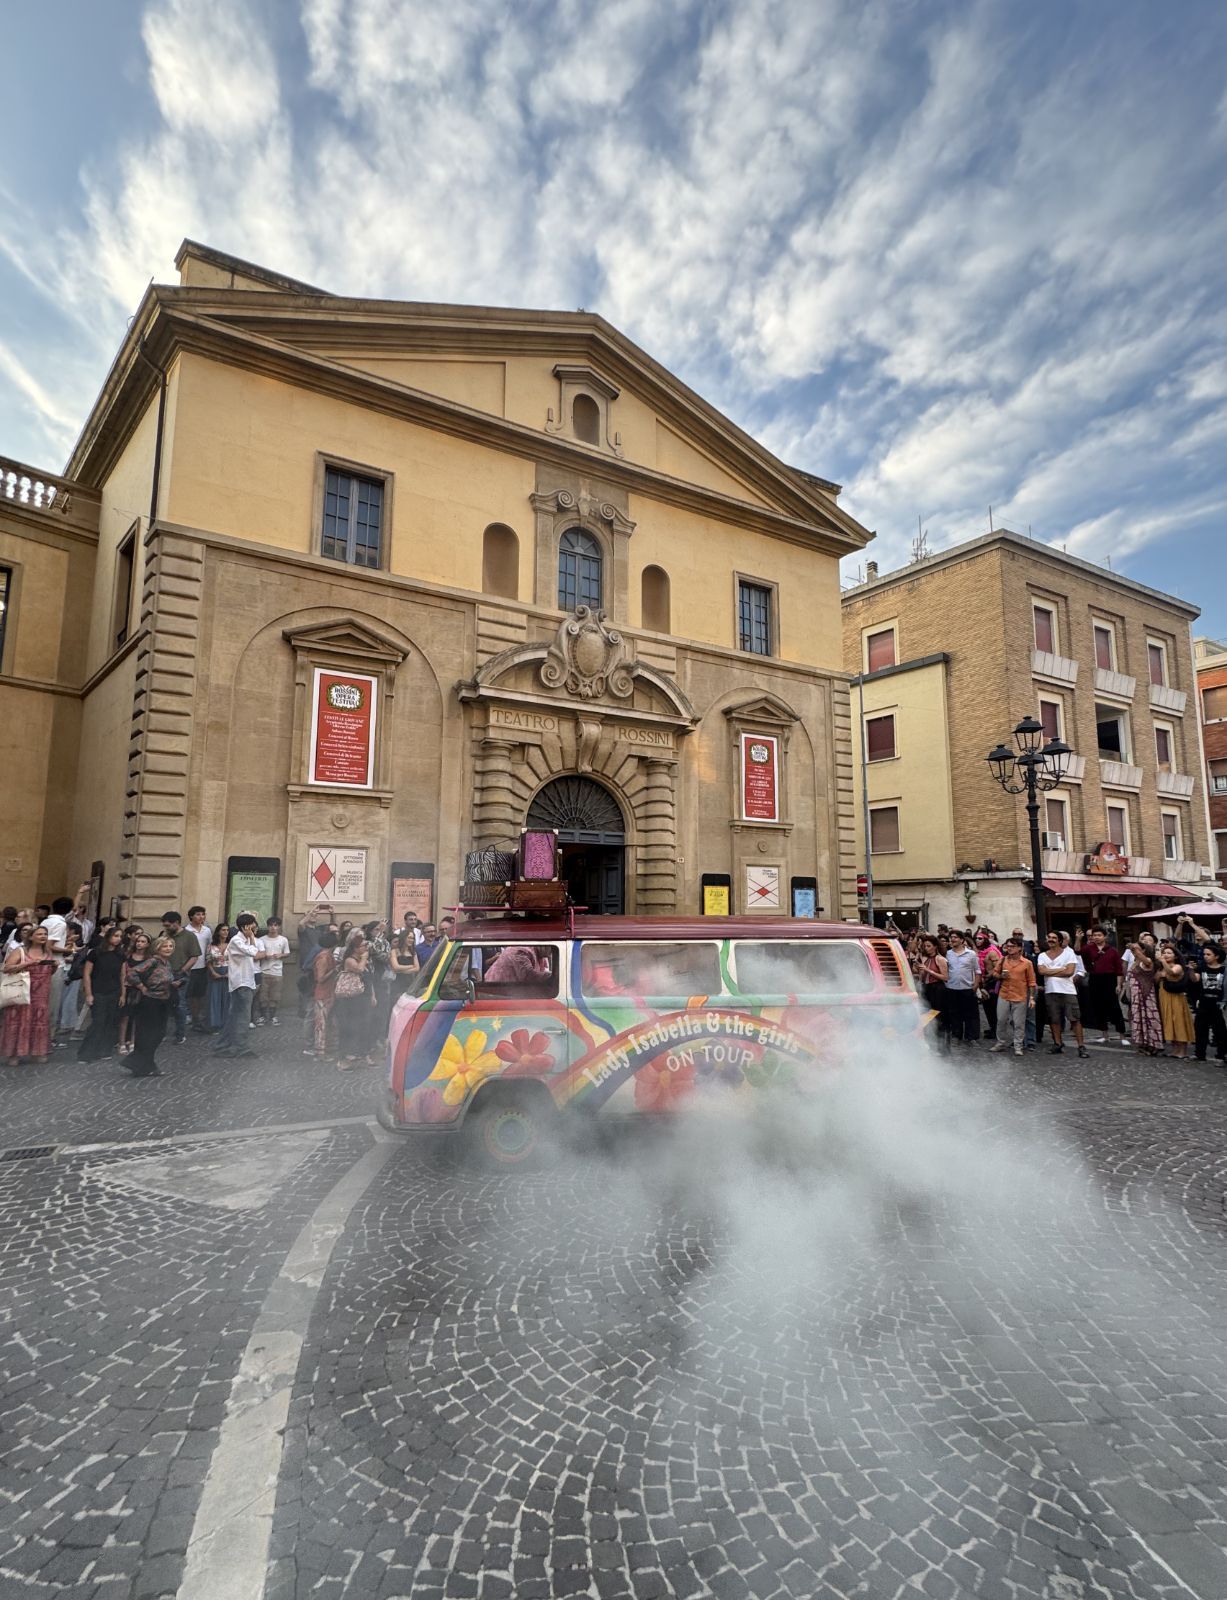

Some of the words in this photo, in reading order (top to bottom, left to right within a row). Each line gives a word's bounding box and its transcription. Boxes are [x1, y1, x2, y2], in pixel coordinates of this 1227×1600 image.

[492, 709, 556, 731] TEATRO
[618, 727, 670, 746] ROSSINI
[582, 1046, 630, 1088] Lady
[628, 1014, 702, 1055] Isabella
[706, 1012, 720, 1032] &
[724, 1015, 754, 1037] the
[758, 1025, 801, 1054] girls
[666, 1050, 694, 1072] ON
[701, 1045, 755, 1067] TOUR
